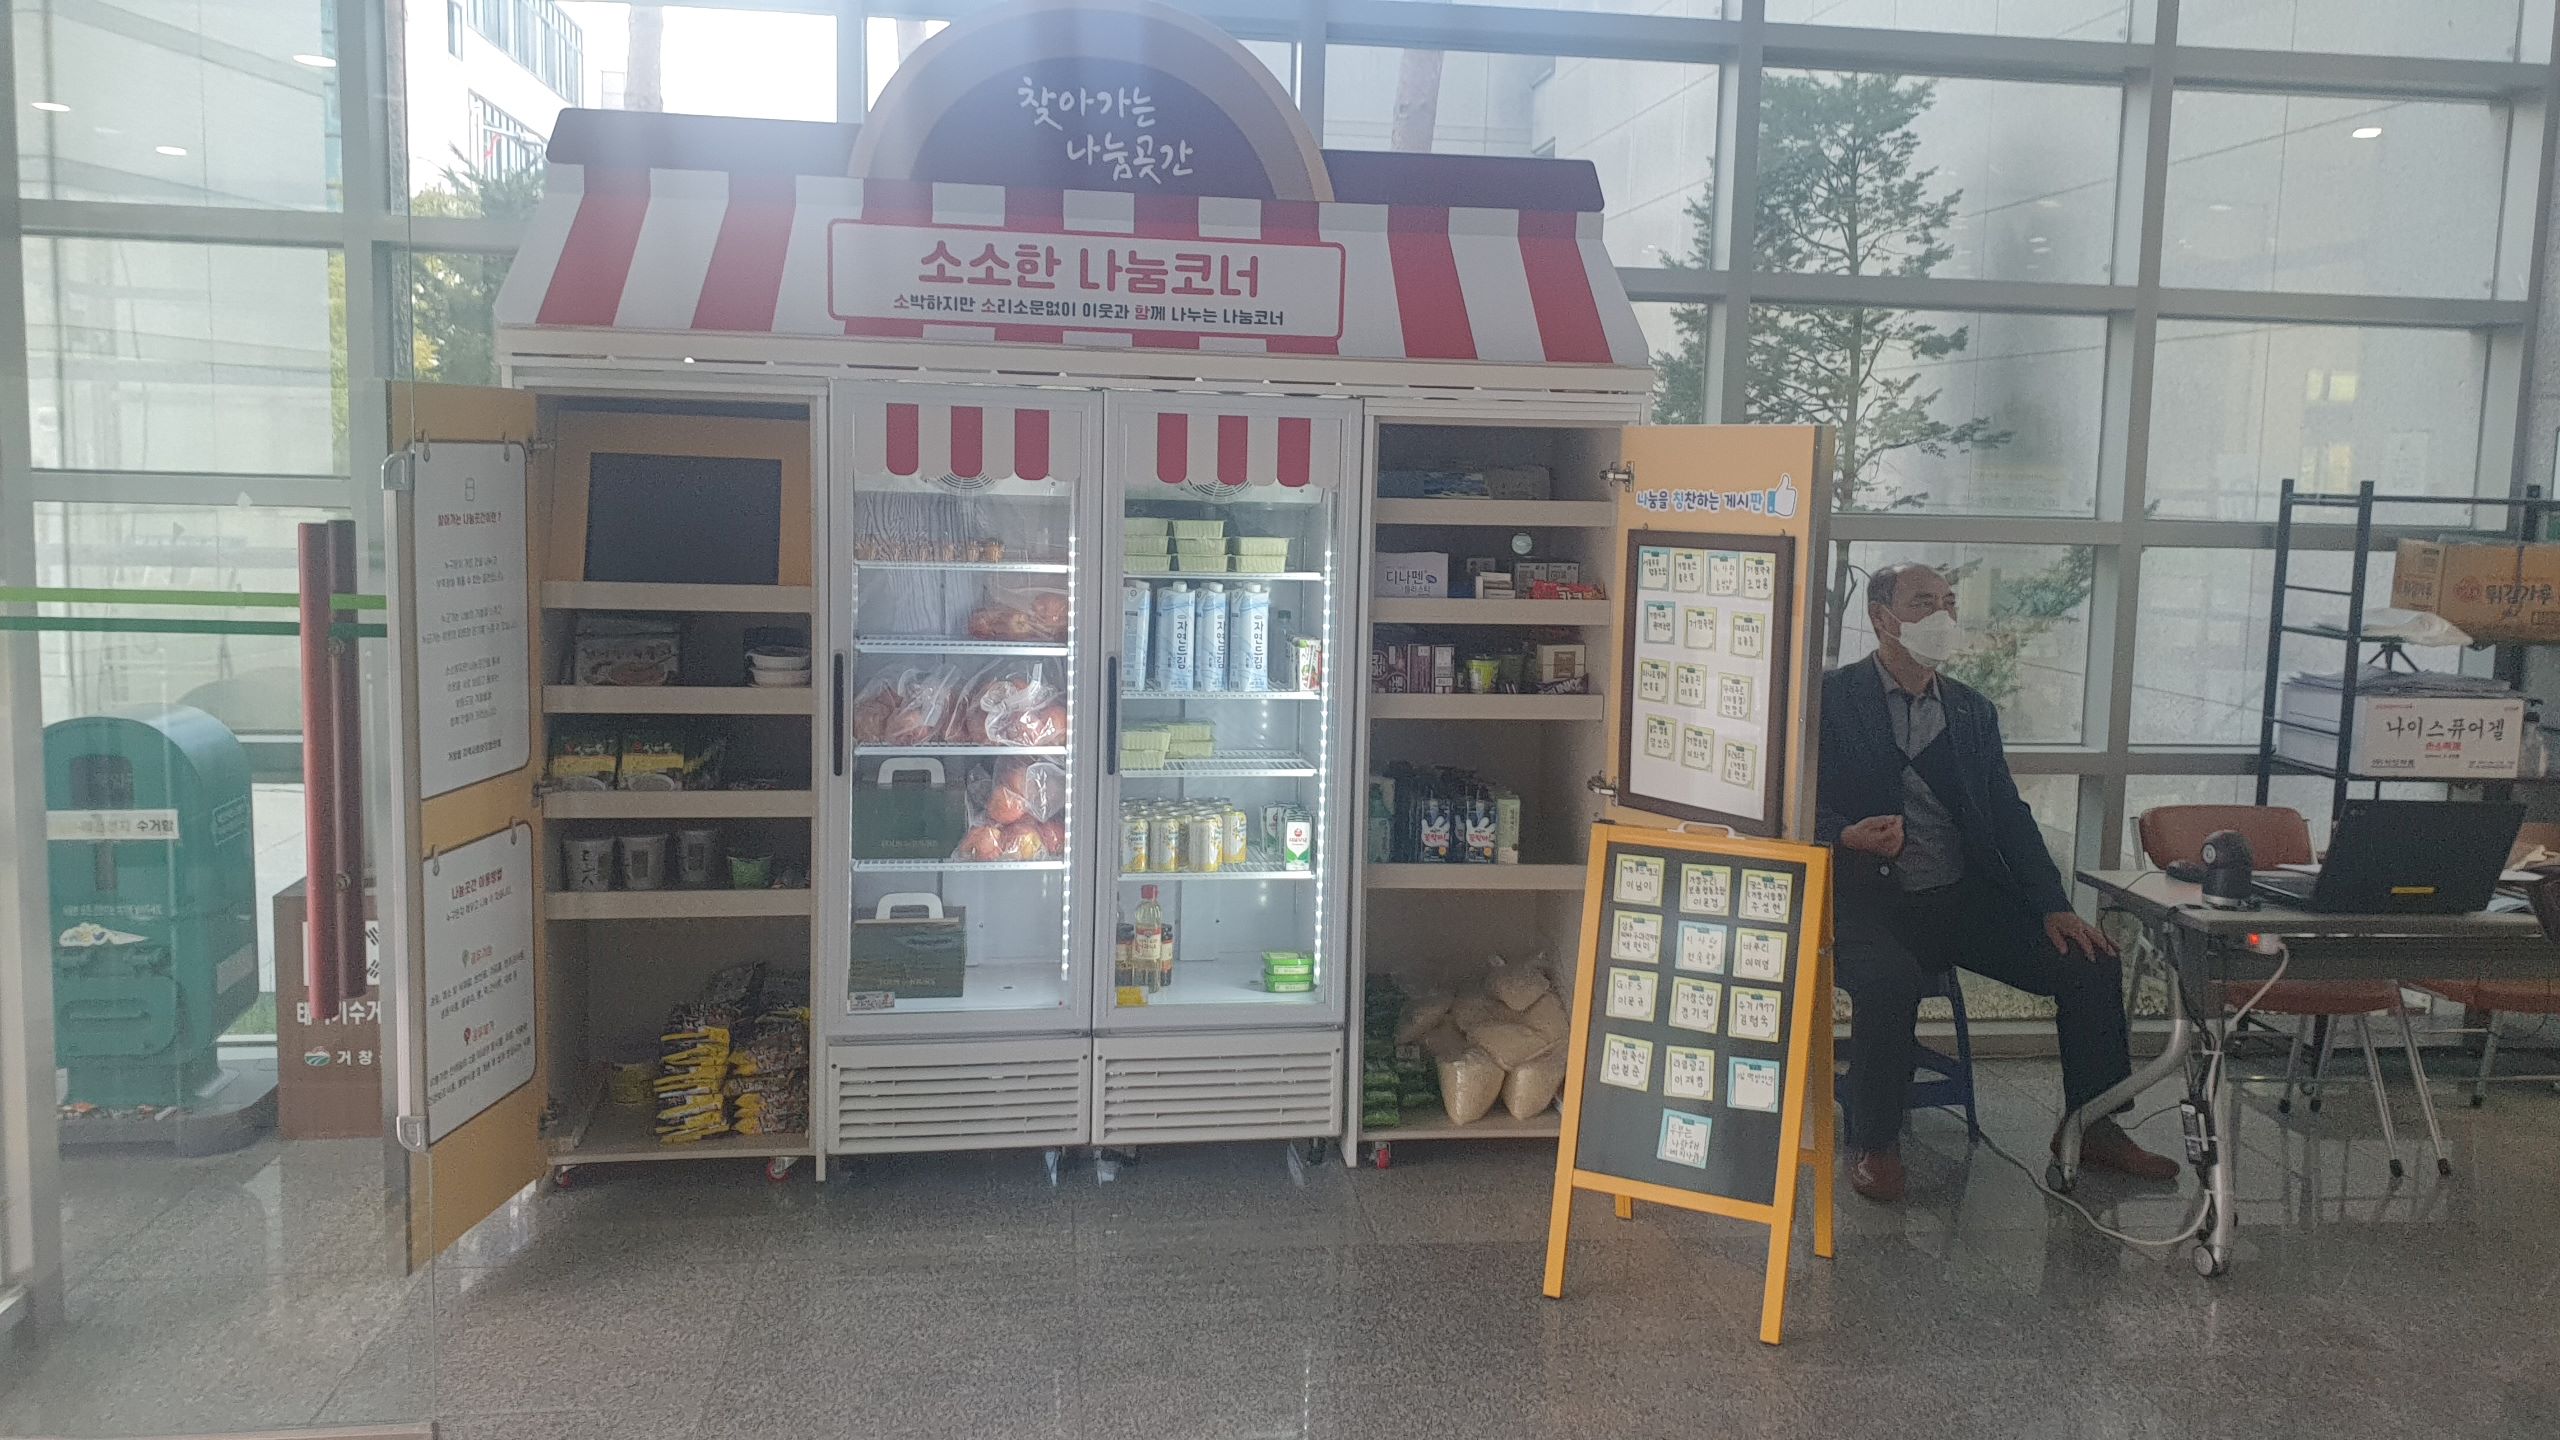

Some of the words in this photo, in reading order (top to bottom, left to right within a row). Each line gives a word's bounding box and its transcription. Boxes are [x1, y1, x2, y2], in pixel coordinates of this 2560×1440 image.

[1019, 76, 1157, 130] 찾아가는
[1066, 132, 1194, 185] 나눔곳간
[918, 240, 1061, 290] 소소한
[1080, 248, 1260, 298] 나눔코너
[893, 293, 975, 313] 소박하지만
[981, 297, 1076, 317] 소리소문없이
[1082, 303, 1130, 321] 이웃과
[1134, 304, 1166, 322] 함께
[1171, 306, 1217, 324] 나누는
[1222, 309, 1284, 327] 나눔코너
[1637, 491, 1668, 509] 나눔을
[1673, 492, 1720, 511] 칭찬하는
[1724, 493, 1763, 512] 게시판
[1253, 621, 1264, 670] 자연드림
[2386, 716, 2506, 742] 나이스퓨어겔
